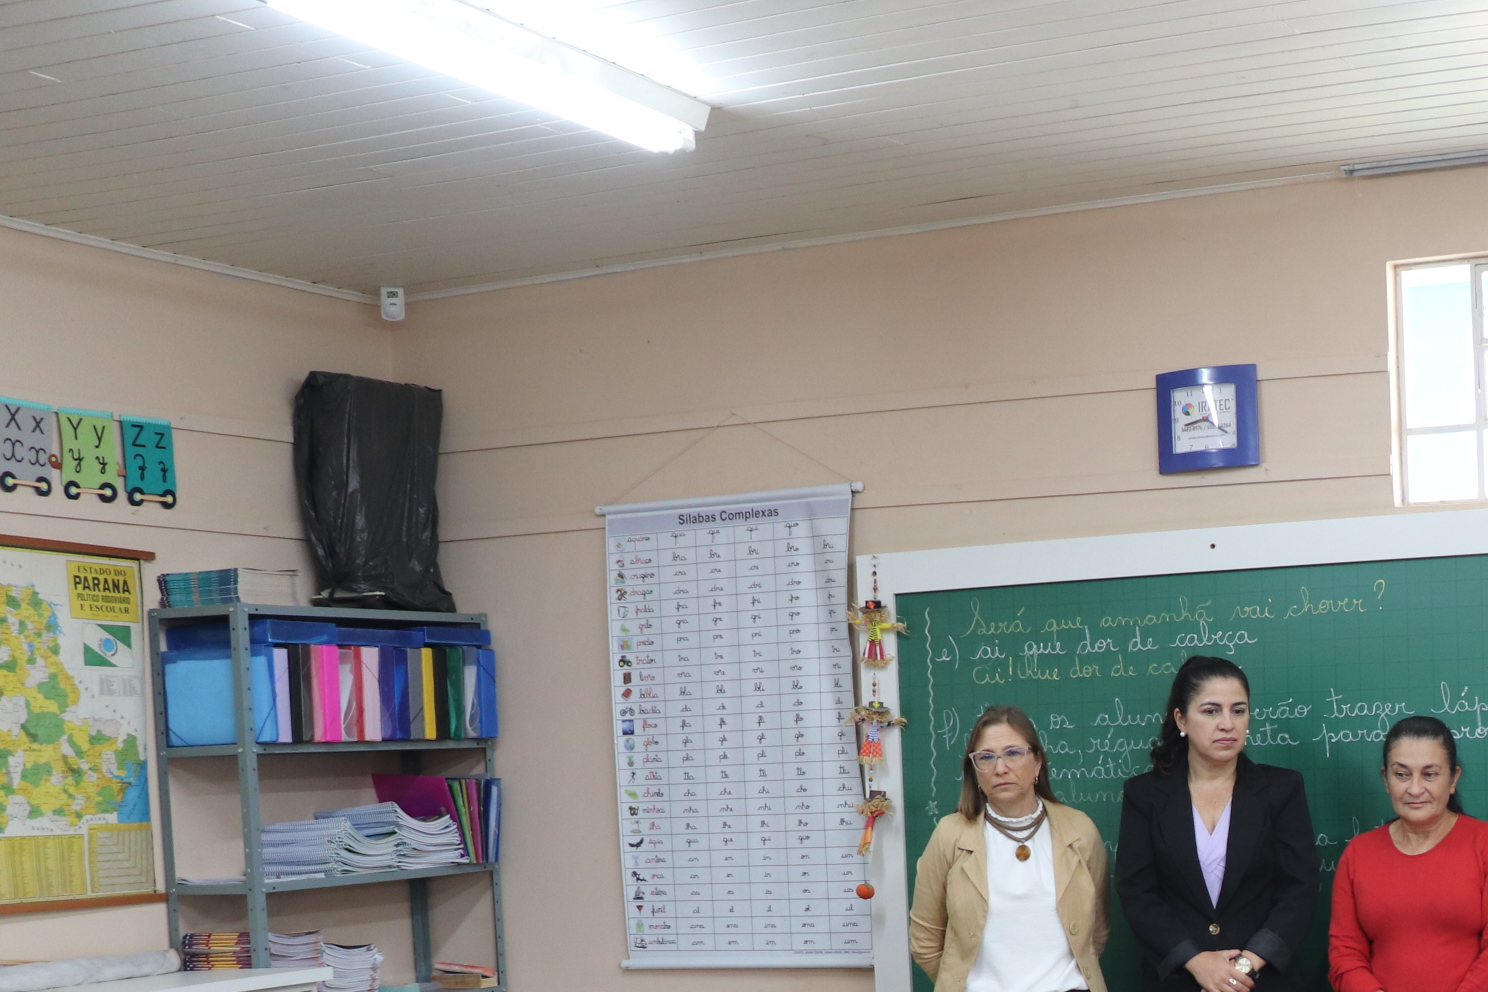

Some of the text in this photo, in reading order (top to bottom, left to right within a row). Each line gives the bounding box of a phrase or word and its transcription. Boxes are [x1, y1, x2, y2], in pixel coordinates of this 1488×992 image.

[5, 404, 22, 431] X
[67, 417, 105, 449] Y y
[130, 424, 147, 448] Z
[678, 507, 779, 525] Sílabas Complexas
[77, 565, 127, 577] ESTADO DO
[73, 575, 131, 594] PARANÁ
[80, 603, 131, 614] E ESCOLAR
[960, 597, 1031, 637] Será
[1041, 616, 1086, 644] que
[1100, 596, 1214, 628] amanhã
[1229, 598, 1275, 621] vai
[970, 639, 1006, 660] ai
[1019, 640, 1066, 672] que
[1076, 625, 1119, 655] dor
[1128, 626, 1159, 652] de
[1169, 621, 1258, 655] cabeça
[1070, 656, 1102, 679] dor
[1110, 654, 1141, 677] de
[1323, 688, 1416, 733] trazer
